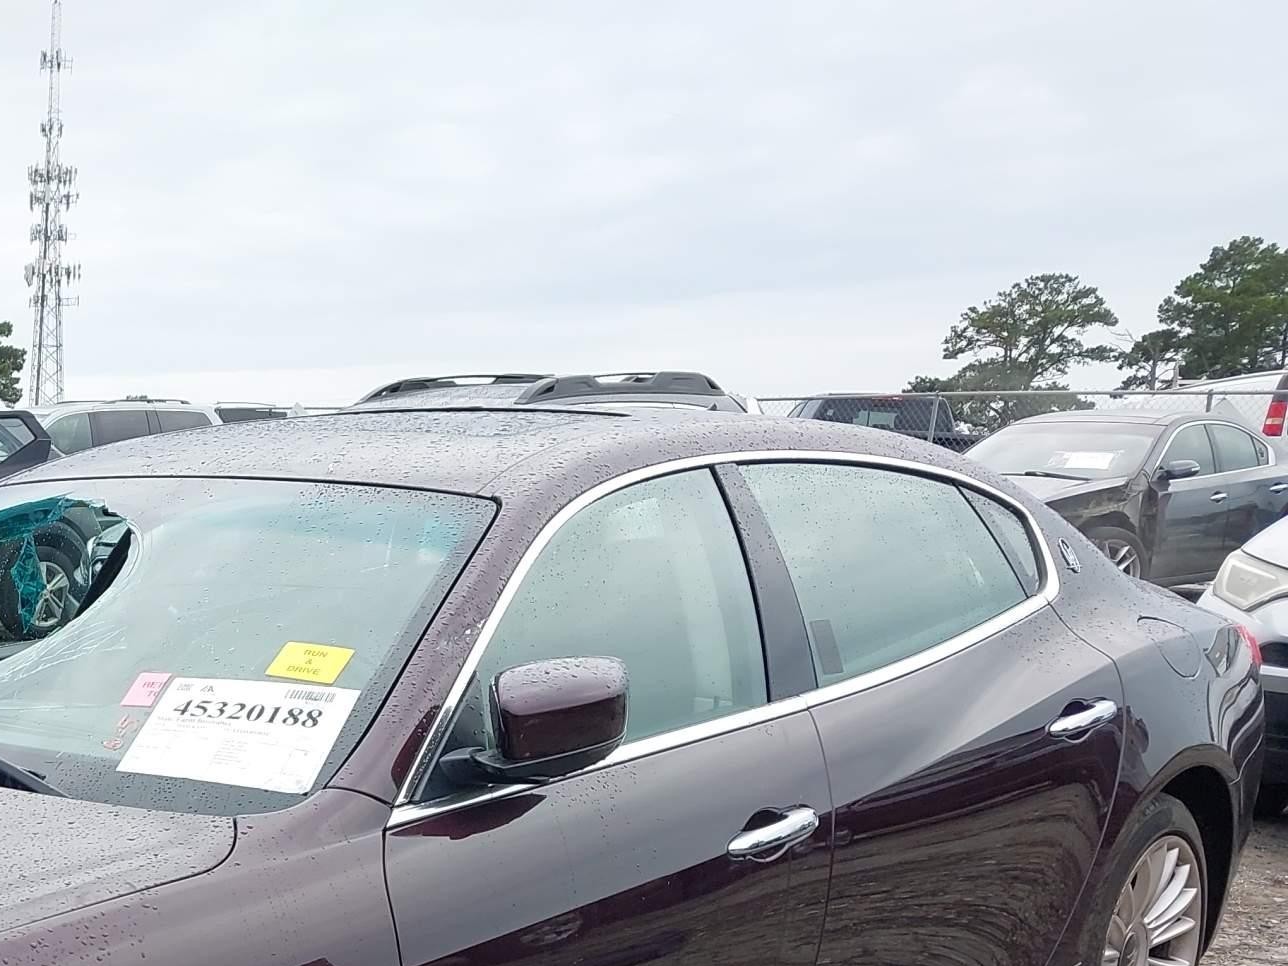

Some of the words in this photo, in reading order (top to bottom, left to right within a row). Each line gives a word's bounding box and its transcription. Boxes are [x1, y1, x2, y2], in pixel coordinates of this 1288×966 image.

[304, 649, 329, 658] RUN
[286, 665, 321, 676] DRIVE
[173, 699, 324, 729] 45320188
